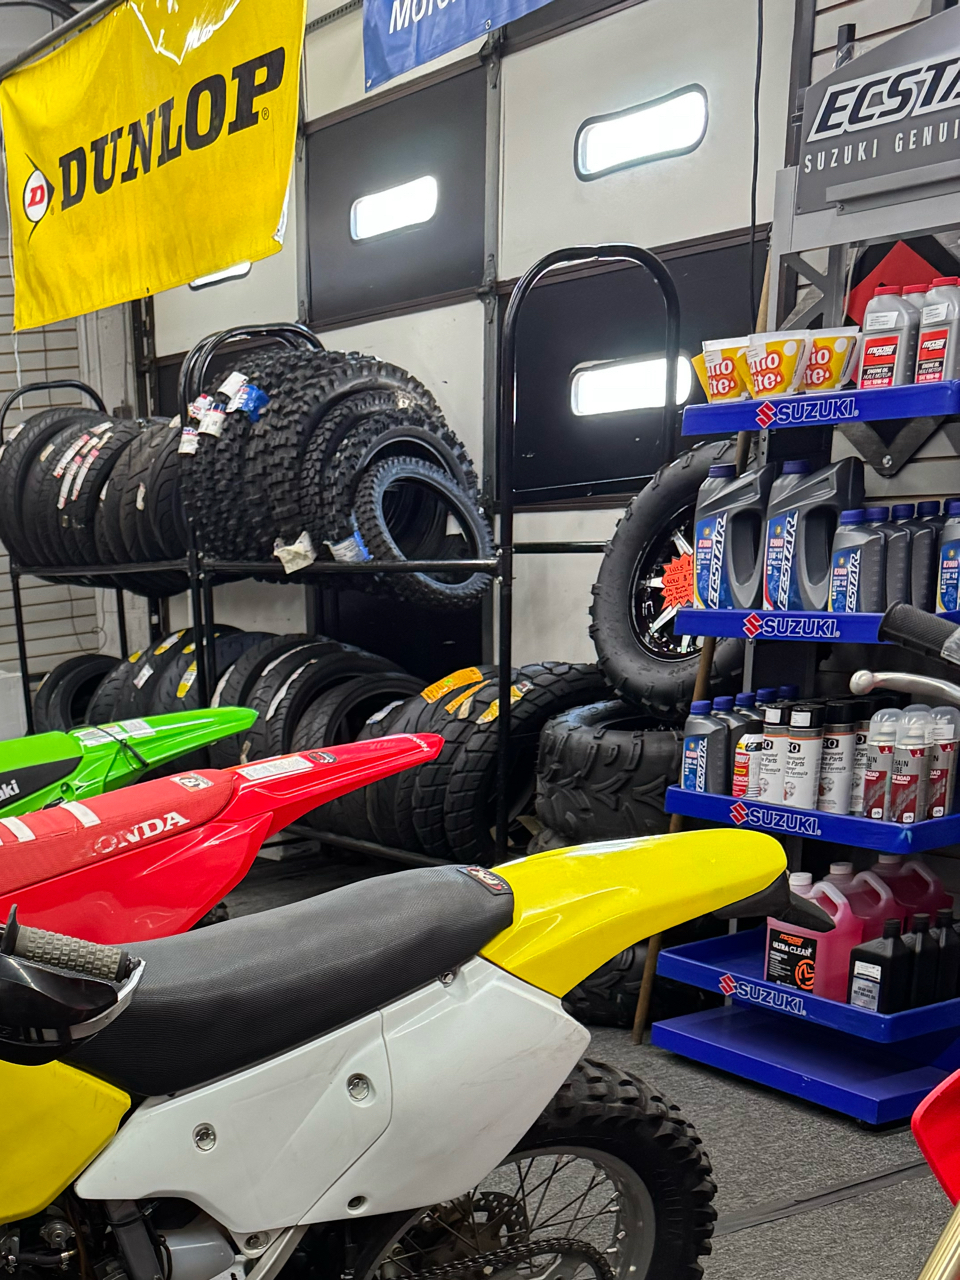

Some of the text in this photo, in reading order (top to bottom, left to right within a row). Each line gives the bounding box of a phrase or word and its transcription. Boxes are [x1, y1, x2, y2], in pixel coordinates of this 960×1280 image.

[59, 46, 285, 212] DUNLOP
[804, 138, 878, 174] SUZUKI
[776, 398, 856, 424] SUZUKI
[762, 617, 837, 638] SUZUKI
[748, 808, 818, 836] SUZUKI
[772, 941, 811, 957] ULTRA CLEAN
[736, 980, 804, 1016] SUZUKI
